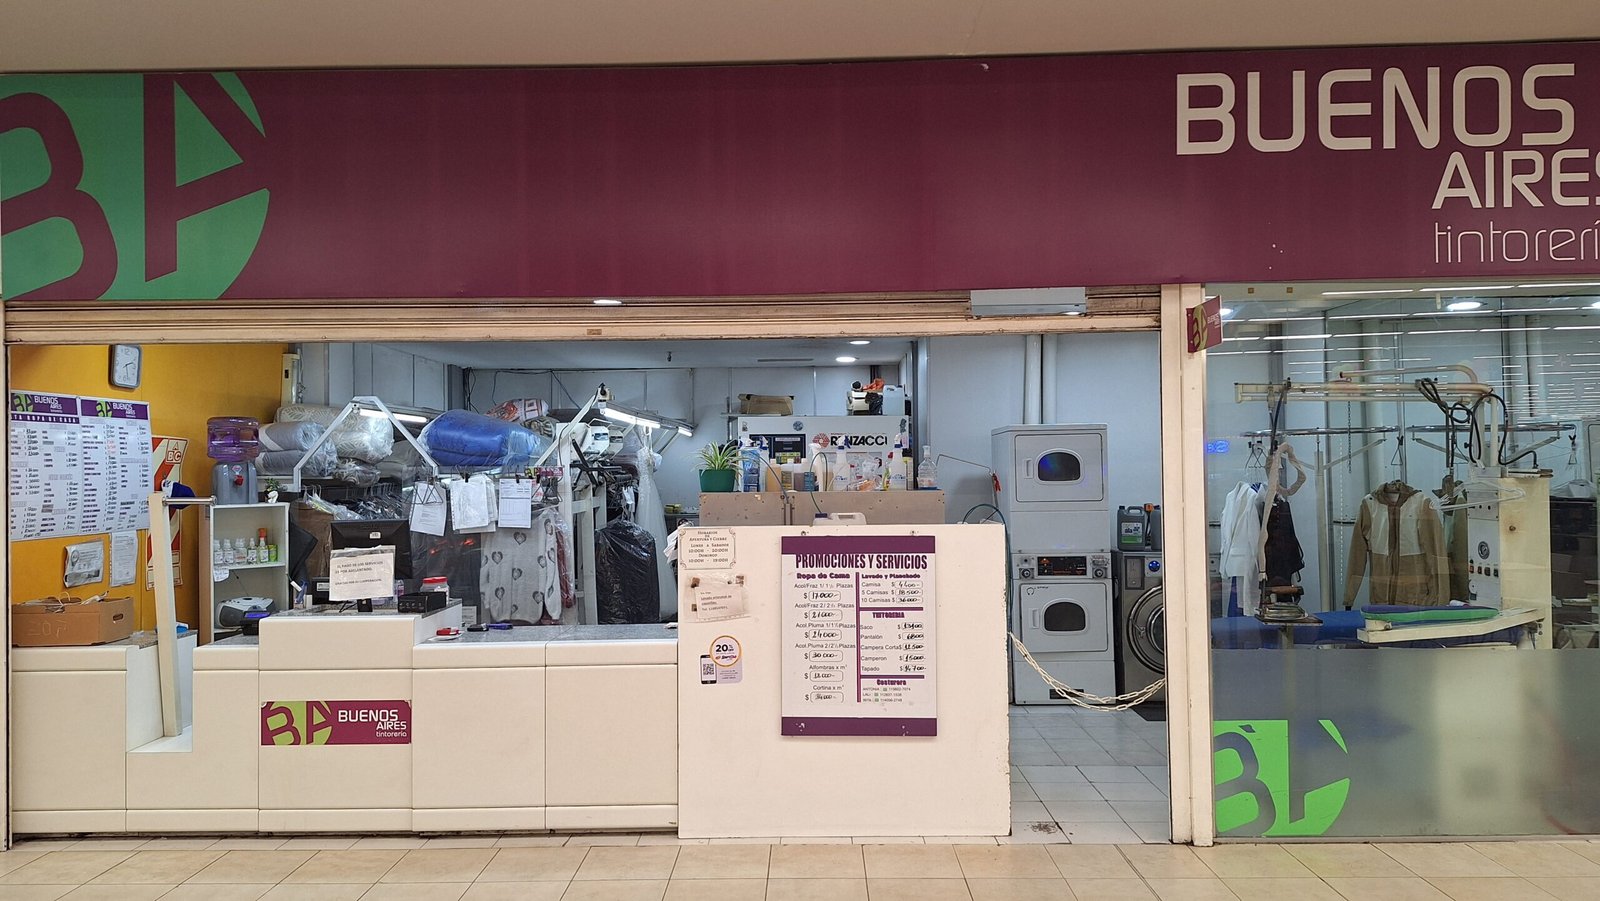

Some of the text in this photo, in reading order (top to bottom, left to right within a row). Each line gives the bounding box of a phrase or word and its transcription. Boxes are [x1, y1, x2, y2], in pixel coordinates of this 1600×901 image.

[1176, 63, 1576, 155] BUENOS
[1431, 148, 1600, 209] AIRE
[830, 435, 888, 446] RNZACCI
[796, 553, 927, 569] PROMOCIONES Y SERVICIOS
[338, 709, 399, 722] BUENOS
[376, 721, 407, 730] AIRES
